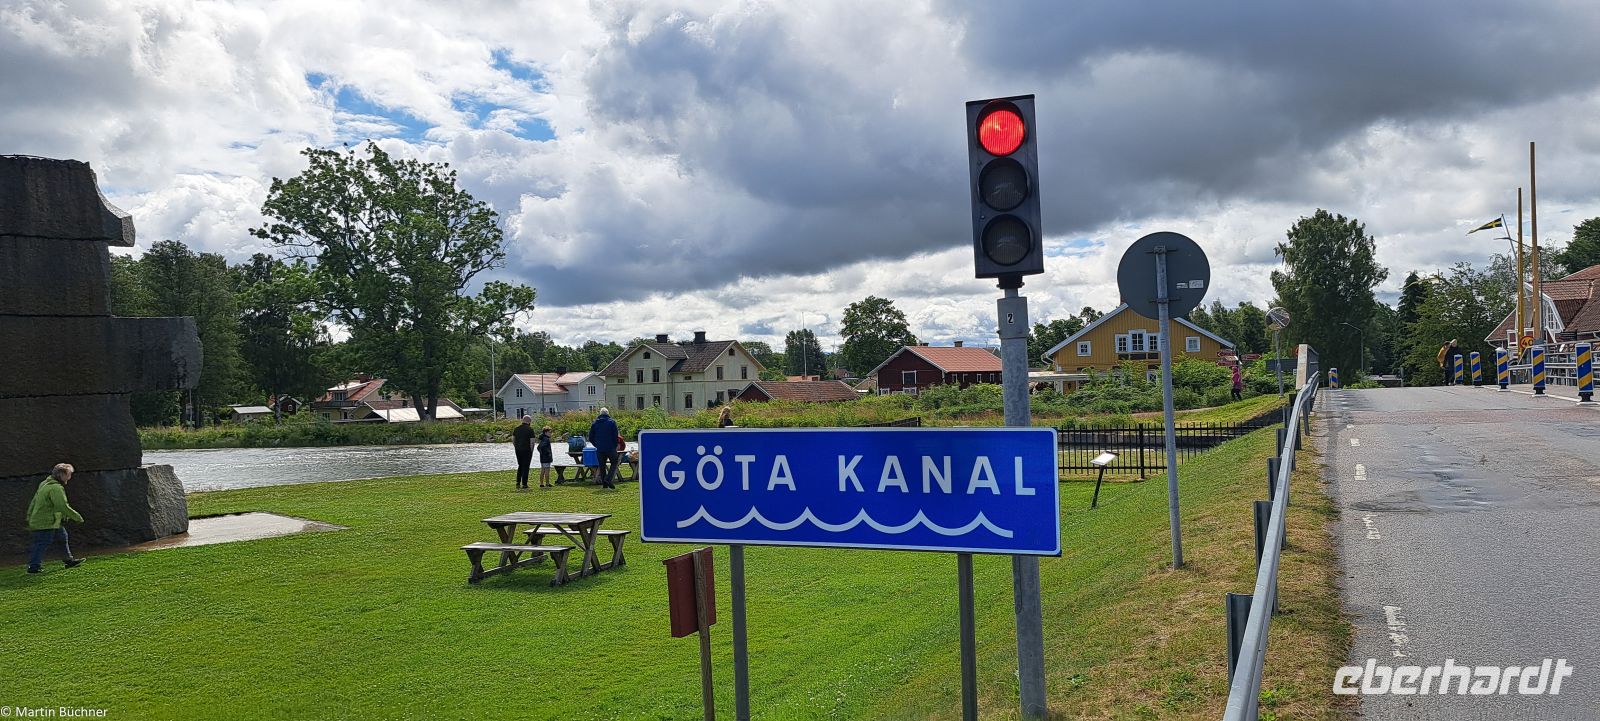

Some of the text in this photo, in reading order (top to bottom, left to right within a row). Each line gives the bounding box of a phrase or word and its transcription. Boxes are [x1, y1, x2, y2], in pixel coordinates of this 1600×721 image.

[1007, 313, 1014, 324] 2
[658, 445, 1036, 496] GÖTA KANAL
